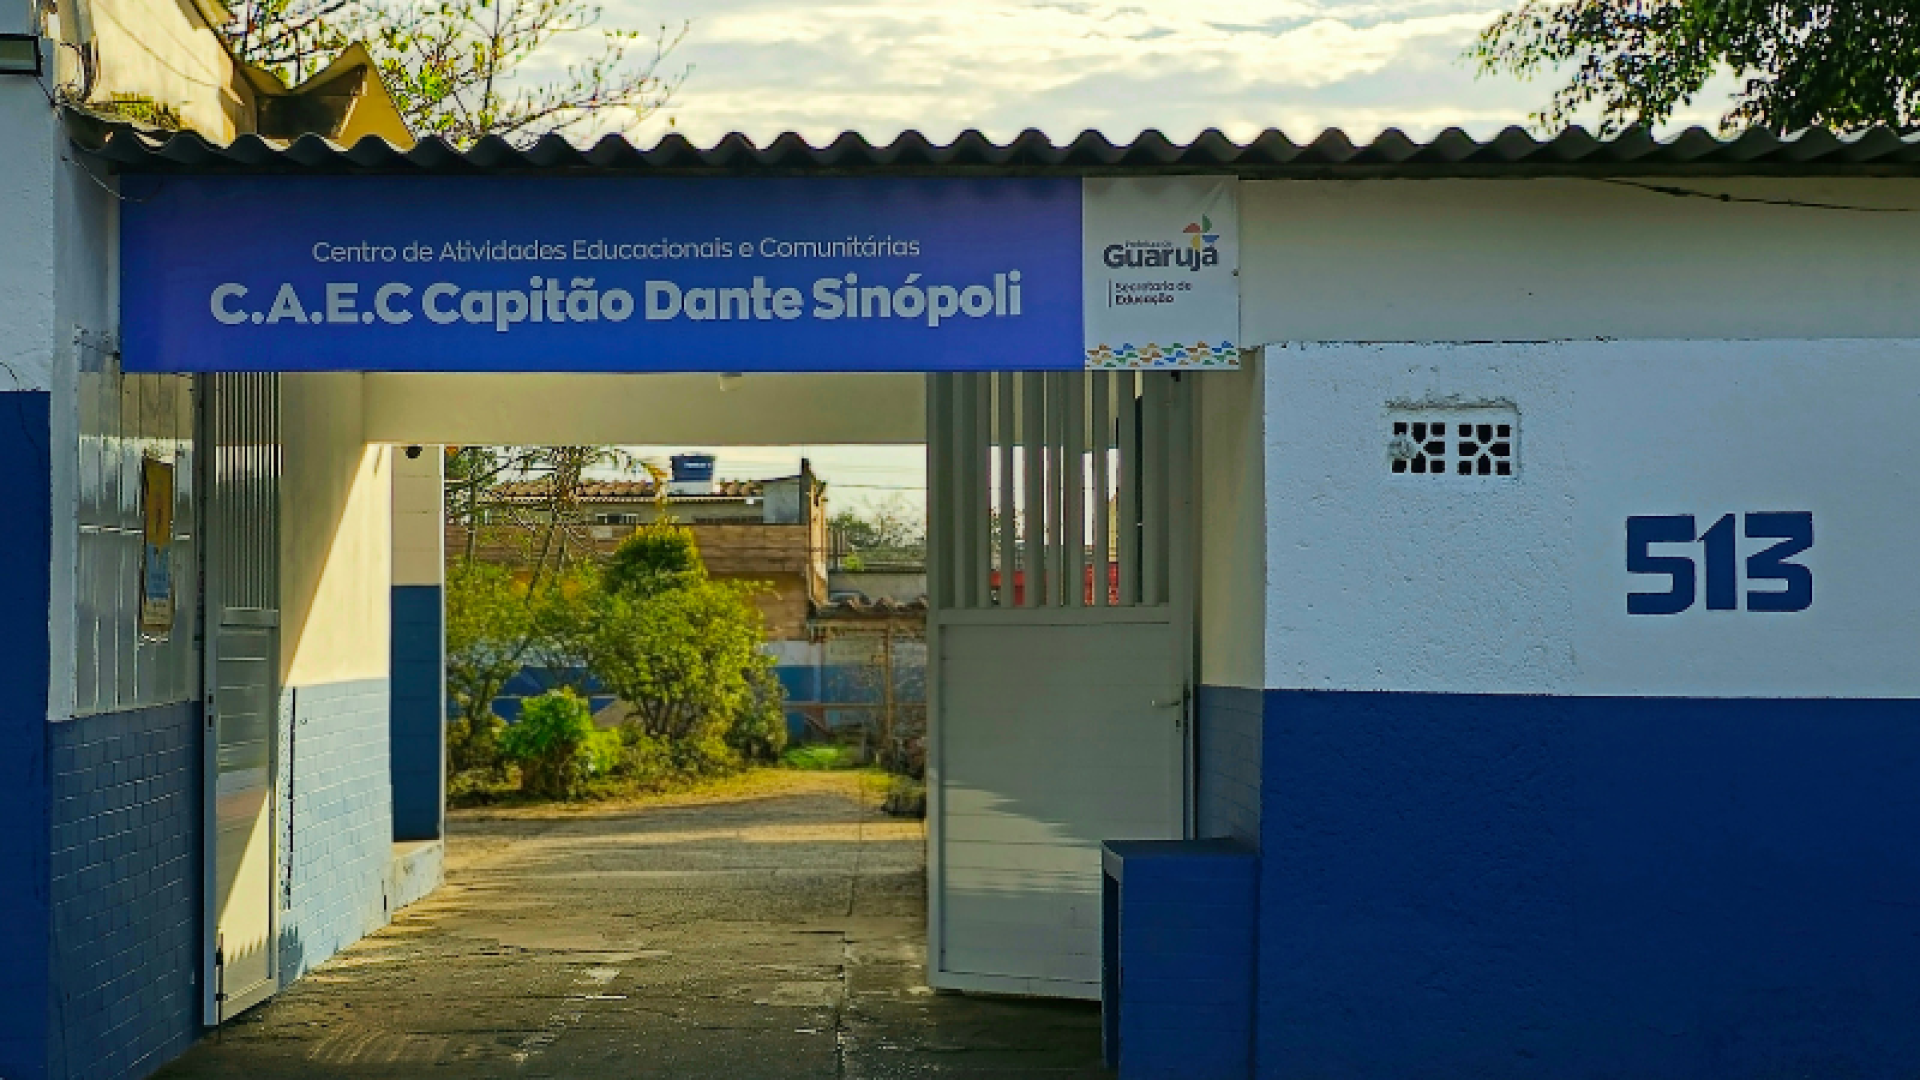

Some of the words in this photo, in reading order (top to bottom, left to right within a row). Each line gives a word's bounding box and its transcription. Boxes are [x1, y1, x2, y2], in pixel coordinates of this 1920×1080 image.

[312, 241, 397, 263] Centro
[402, 240, 433, 263] de
[438, 239, 567, 262] Atividades
[573, 237, 733, 261] Educacionais
[738, 242, 754, 259] e
[759, 235, 920, 259] Comunitárias
[1103, 244, 1219, 272] Guarujá
[210, 282, 414, 325] C.A.E.C
[421, 275, 635, 332] Capitão
[645, 276, 805, 321] Dante
[812, 269, 1022, 328] Sinópoli
[1115, 281, 1175, 293] Secretaria
[1115, 293, 1175, 305] Educação
[1626, 511, 1814, 615] 513
